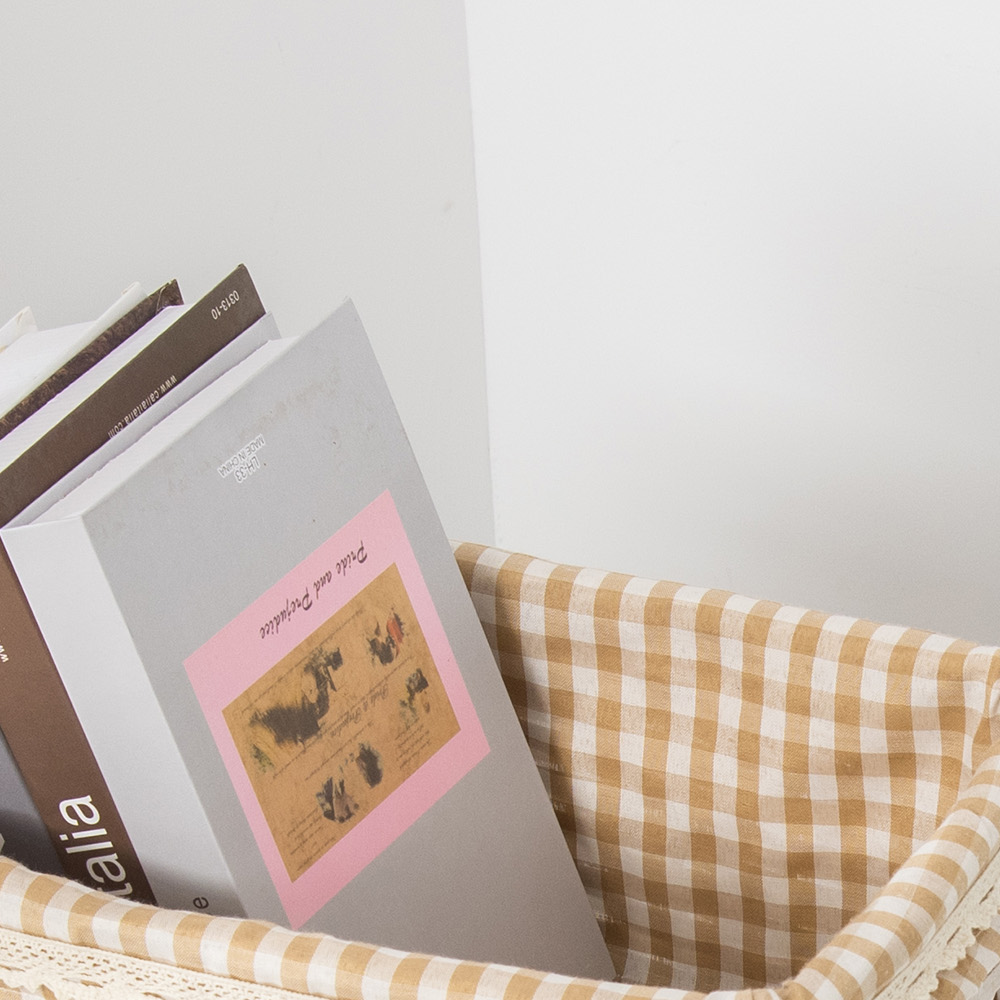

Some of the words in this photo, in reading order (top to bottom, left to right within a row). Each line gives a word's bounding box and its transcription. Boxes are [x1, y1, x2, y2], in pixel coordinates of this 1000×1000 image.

[211, 290, 240, 320] 0313-10
[237, 449, 247, 462] IN
[246, 436, 265, 456] MADE
[218, 456, 240, 477] CHINA
[336, 540, 368, 577] Pride
[312, 568, 333, 600] and
[259, 588, 314, 640] Prejudice
